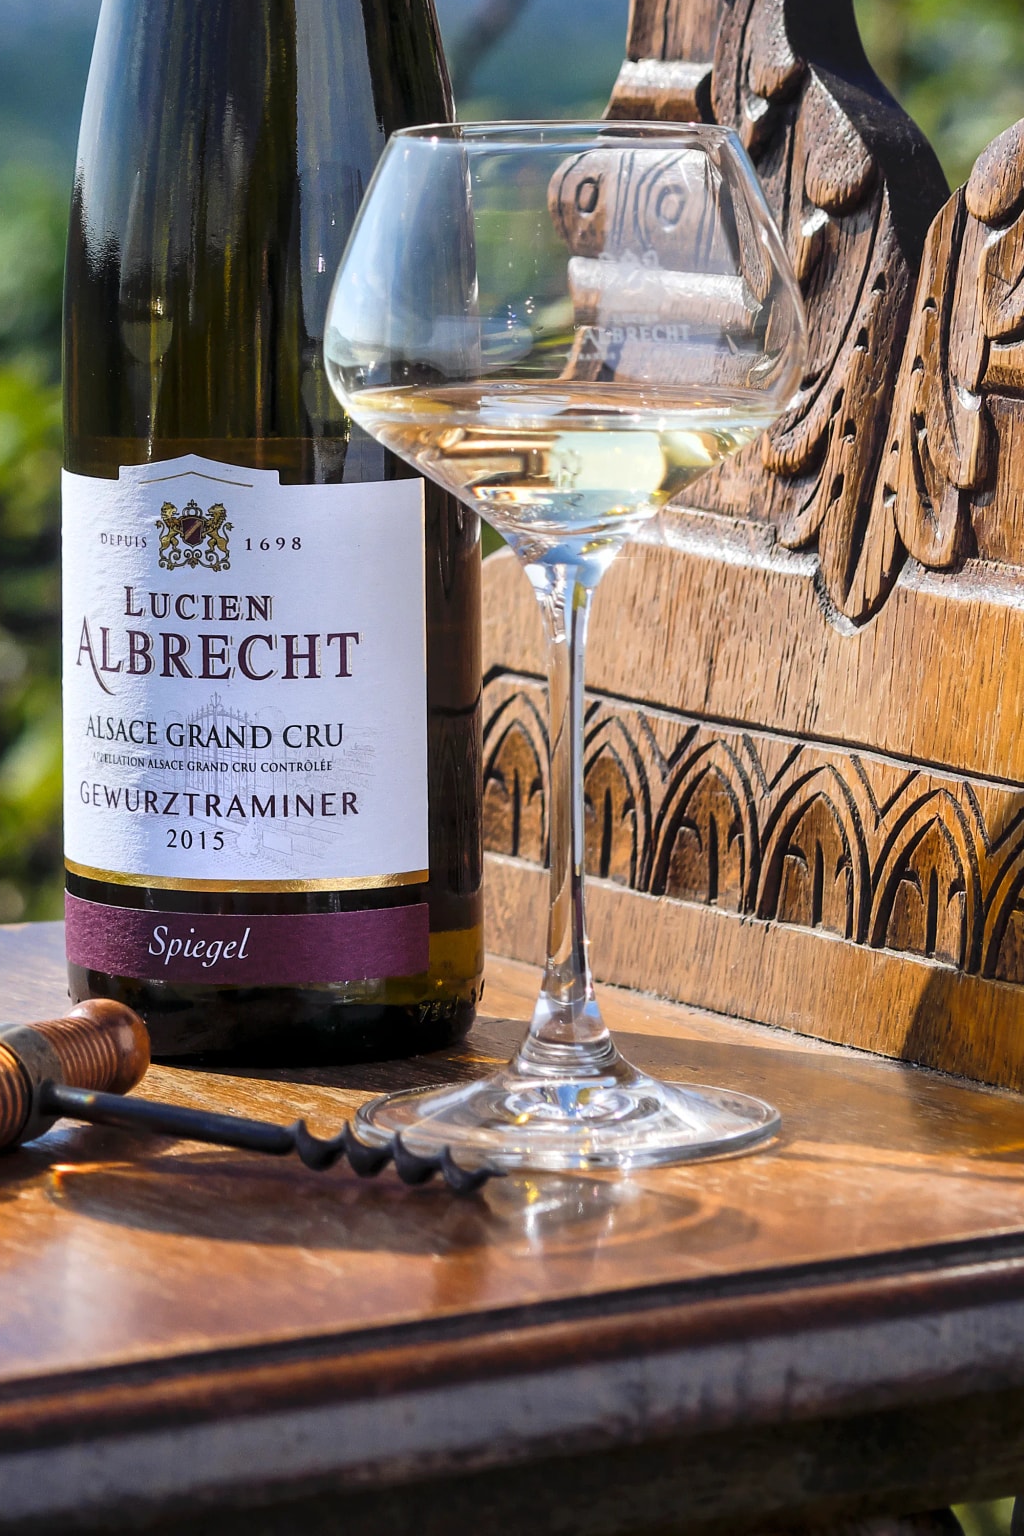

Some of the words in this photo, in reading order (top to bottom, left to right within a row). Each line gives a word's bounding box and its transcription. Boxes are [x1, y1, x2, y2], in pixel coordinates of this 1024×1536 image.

[100, 532, 148, 549] DEPUIS
[244, 536, 303, 552] 1698
[124, 585, 273, 621] LUCIEN
[76, 615, 364, 696] ALBRECHT
[86, 713, 158, 745] ALSACE
[166, 722, 273, 749] GRAND
[282, 722, 345, 749] CRU
[92, 751, 145, 768] APPELLATION
[147, 758, 184, 771] ALSACE
[187, 760, 229, 773] GRAND
[232, 762, 257, 773] CRU
[260, 758, 333, 773] CONTRÔLÉE
[80, 779, 359, 819] GEWURZTRAMINER
[166, 828, 225, 851] 2015
[148, 924, 251, 968] Spiegel
